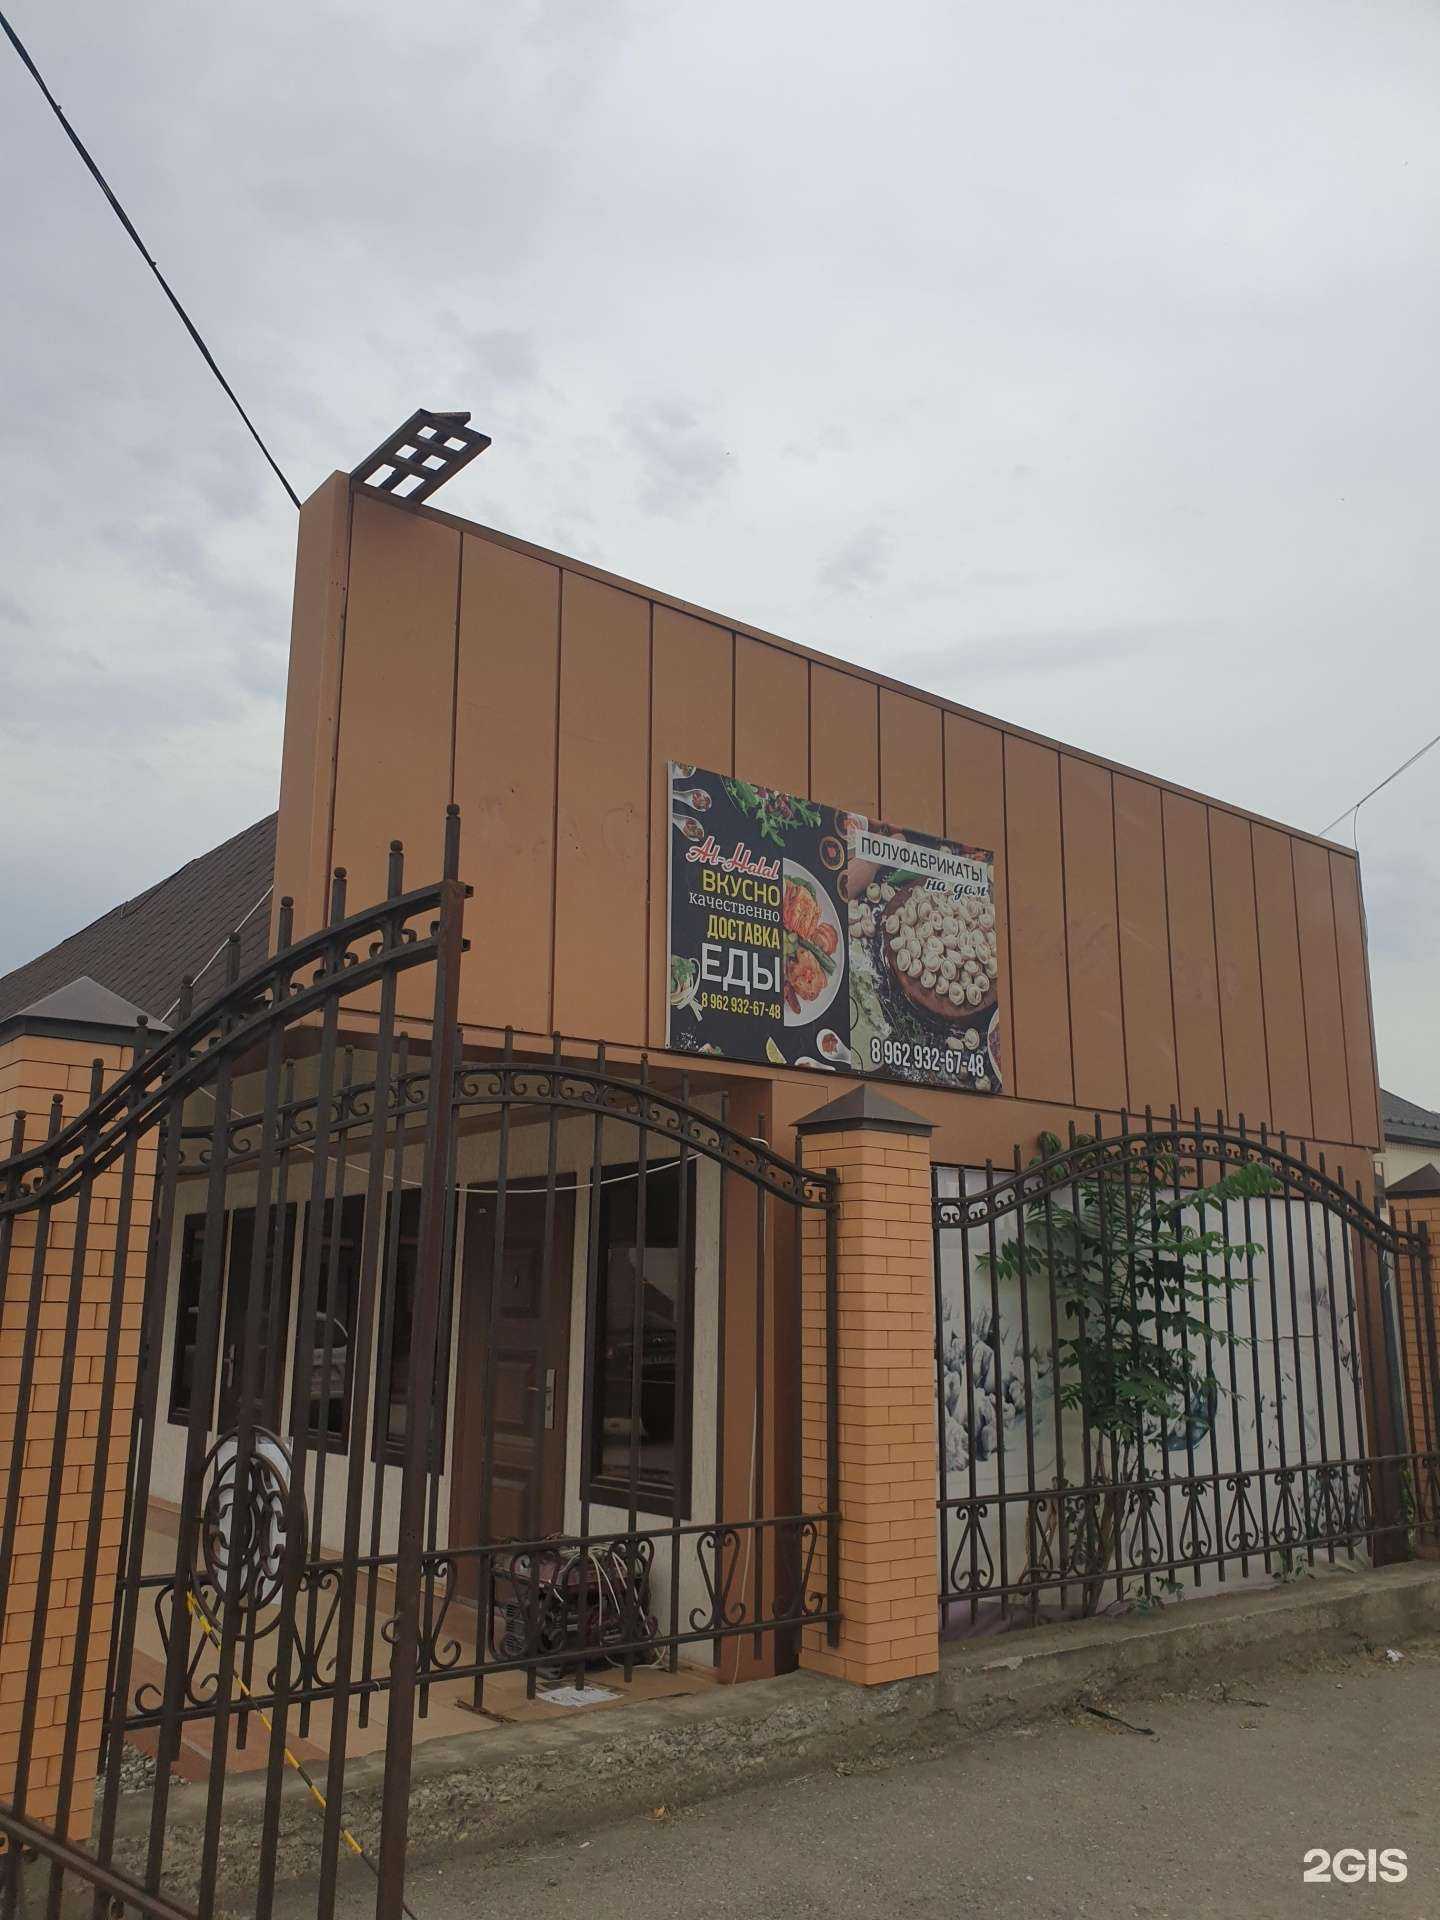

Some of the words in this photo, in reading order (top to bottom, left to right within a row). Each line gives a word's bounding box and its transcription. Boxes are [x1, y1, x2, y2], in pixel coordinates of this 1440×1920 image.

[861, 837, 983, 882] ПОЛУФАБРИКАТЫ
[703, 869, 780, 907] ВКУСНО
[925, 879, 946, 892] на
[689, 892, 780, 922] качественно
[707, 914, 780, 950] ДОСТАВКА
[701, 942, 780, 995] ЕДЫ
[701, 992, 709, 1008] 8
[710, 994, 729, 1011] 962
[731, 998, 781, 1020] 932-67-48
[871, 1038, 881, 1063] 8
[884, 1040, 911, 1067] 962
[913, 1044, 985, 1077] 932-67-48
